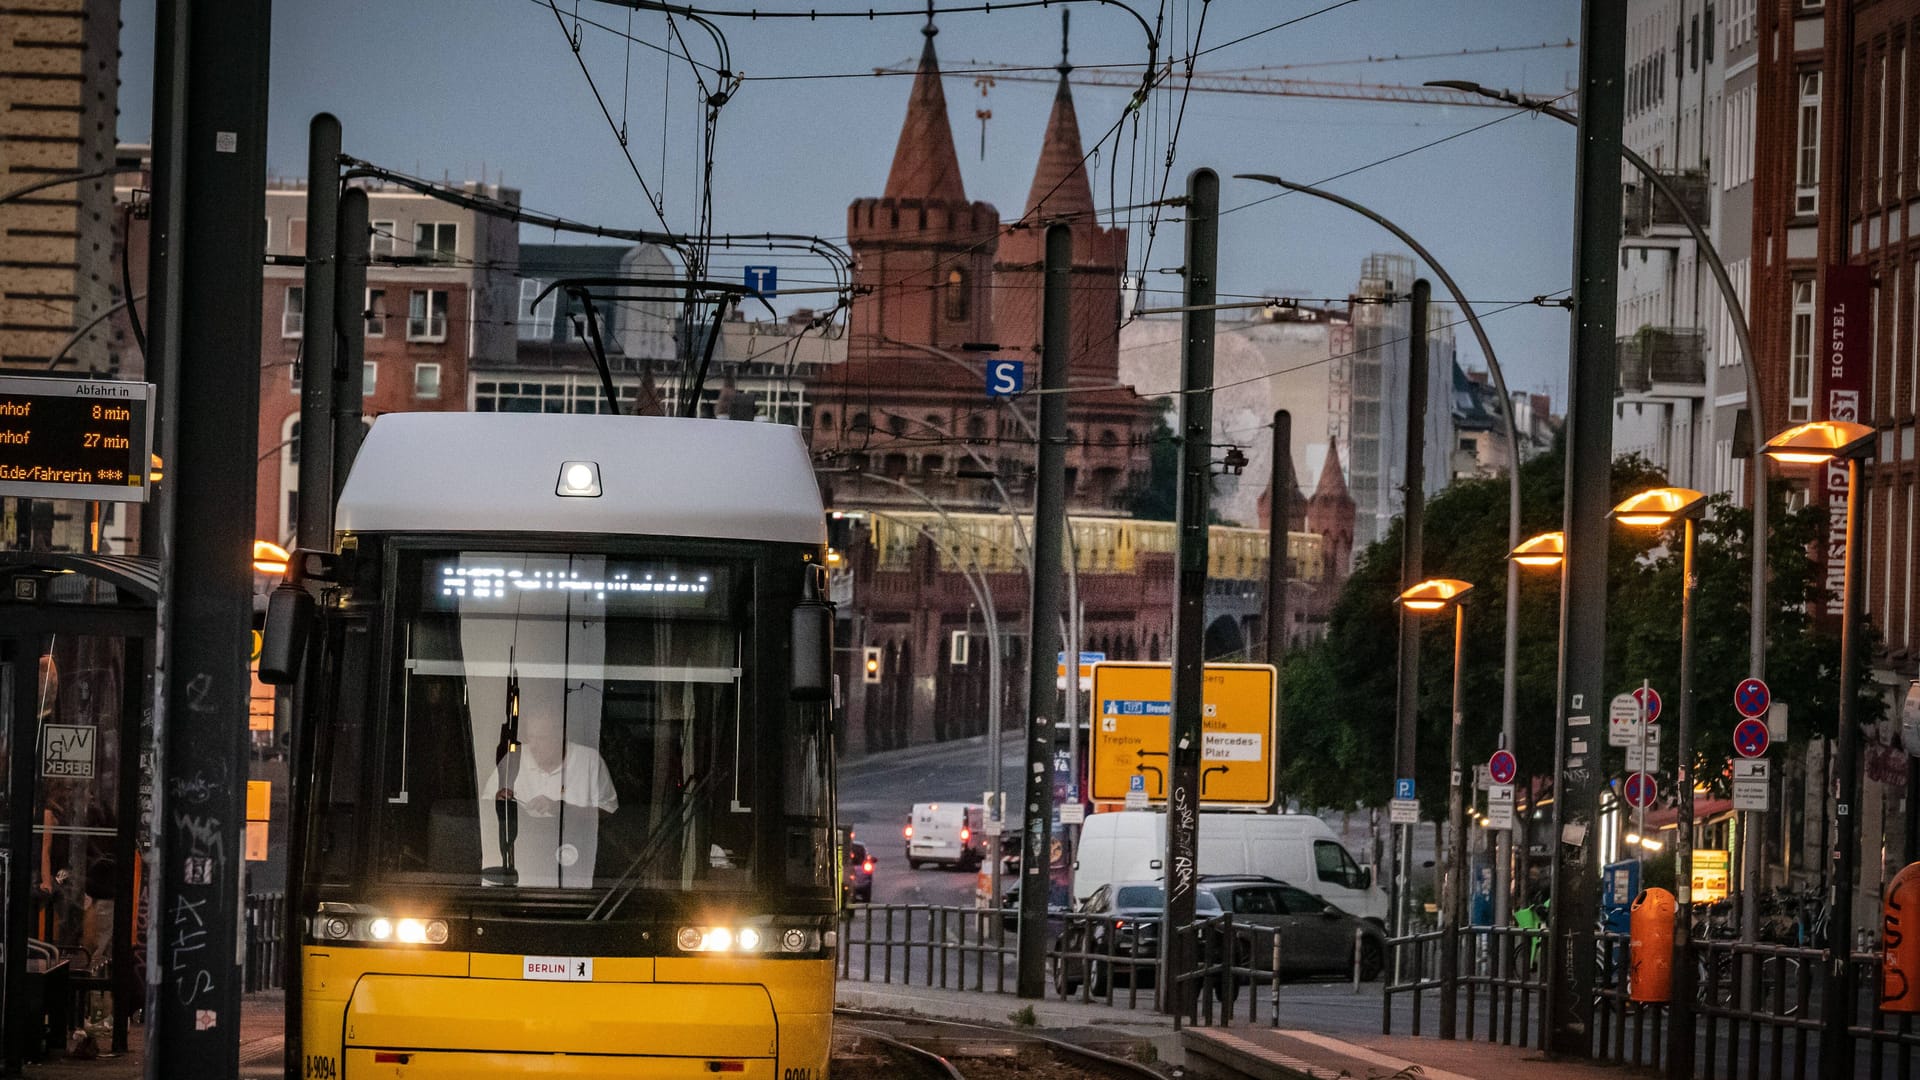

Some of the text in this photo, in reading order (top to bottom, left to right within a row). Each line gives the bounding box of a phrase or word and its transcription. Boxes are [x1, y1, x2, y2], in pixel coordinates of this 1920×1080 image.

[1831, 303, 1845, 378] HOSTEL
[993, 363, 1016, 394] S
[76, 384, 130, 397] Abfahrt in
[92, 405, 130, 420] 8 min
[83, 433, 129, 449] 27 min
[1103, 735, 1142, 746] Treptow
[1206, 735, 1259, 746] Mercedes-
[1205, 748, 1230, 758] Platz
[1400, 781, 1410, 796] P
[528, 963, 566, 974] BERLIN
